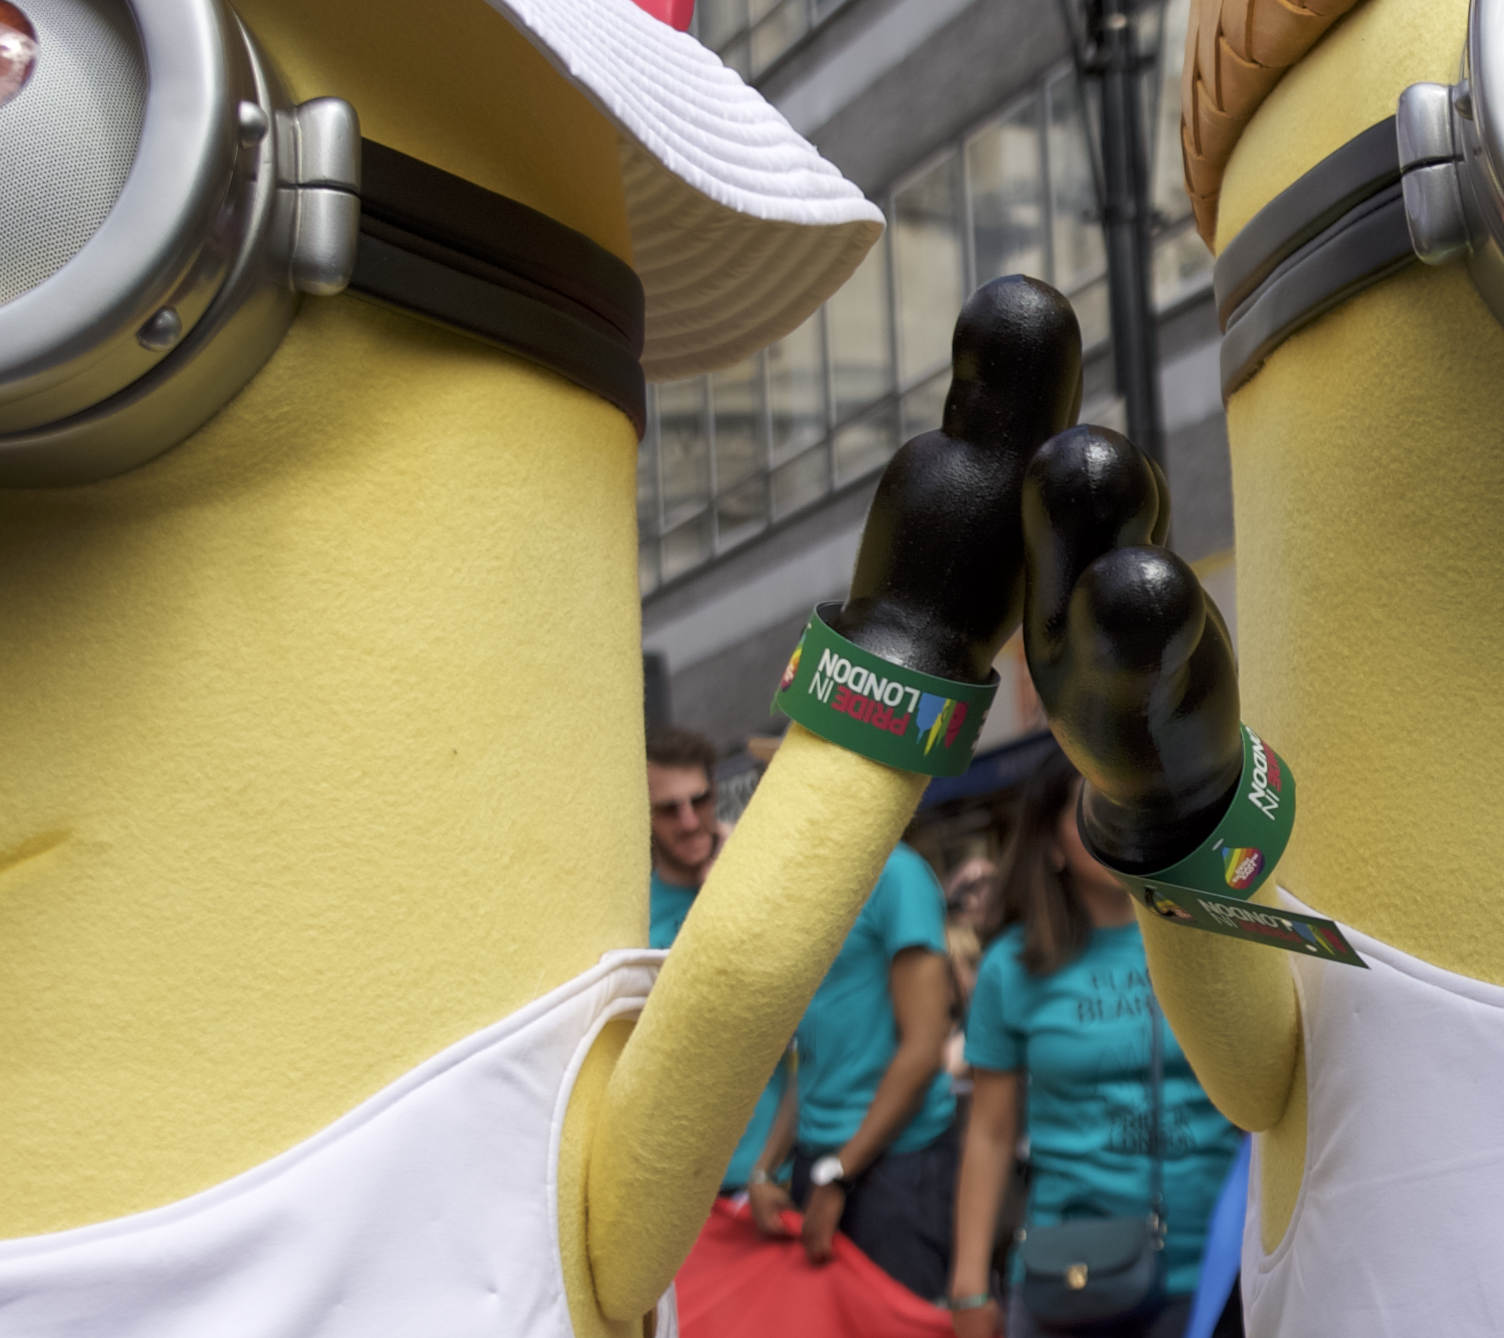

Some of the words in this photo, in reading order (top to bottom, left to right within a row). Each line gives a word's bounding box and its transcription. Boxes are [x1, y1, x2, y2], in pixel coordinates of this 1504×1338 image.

[808, 671, 835, 704] IN
[817, 647, 921, 714] LONDON
[830, 684, 911, 736] PRIDE
